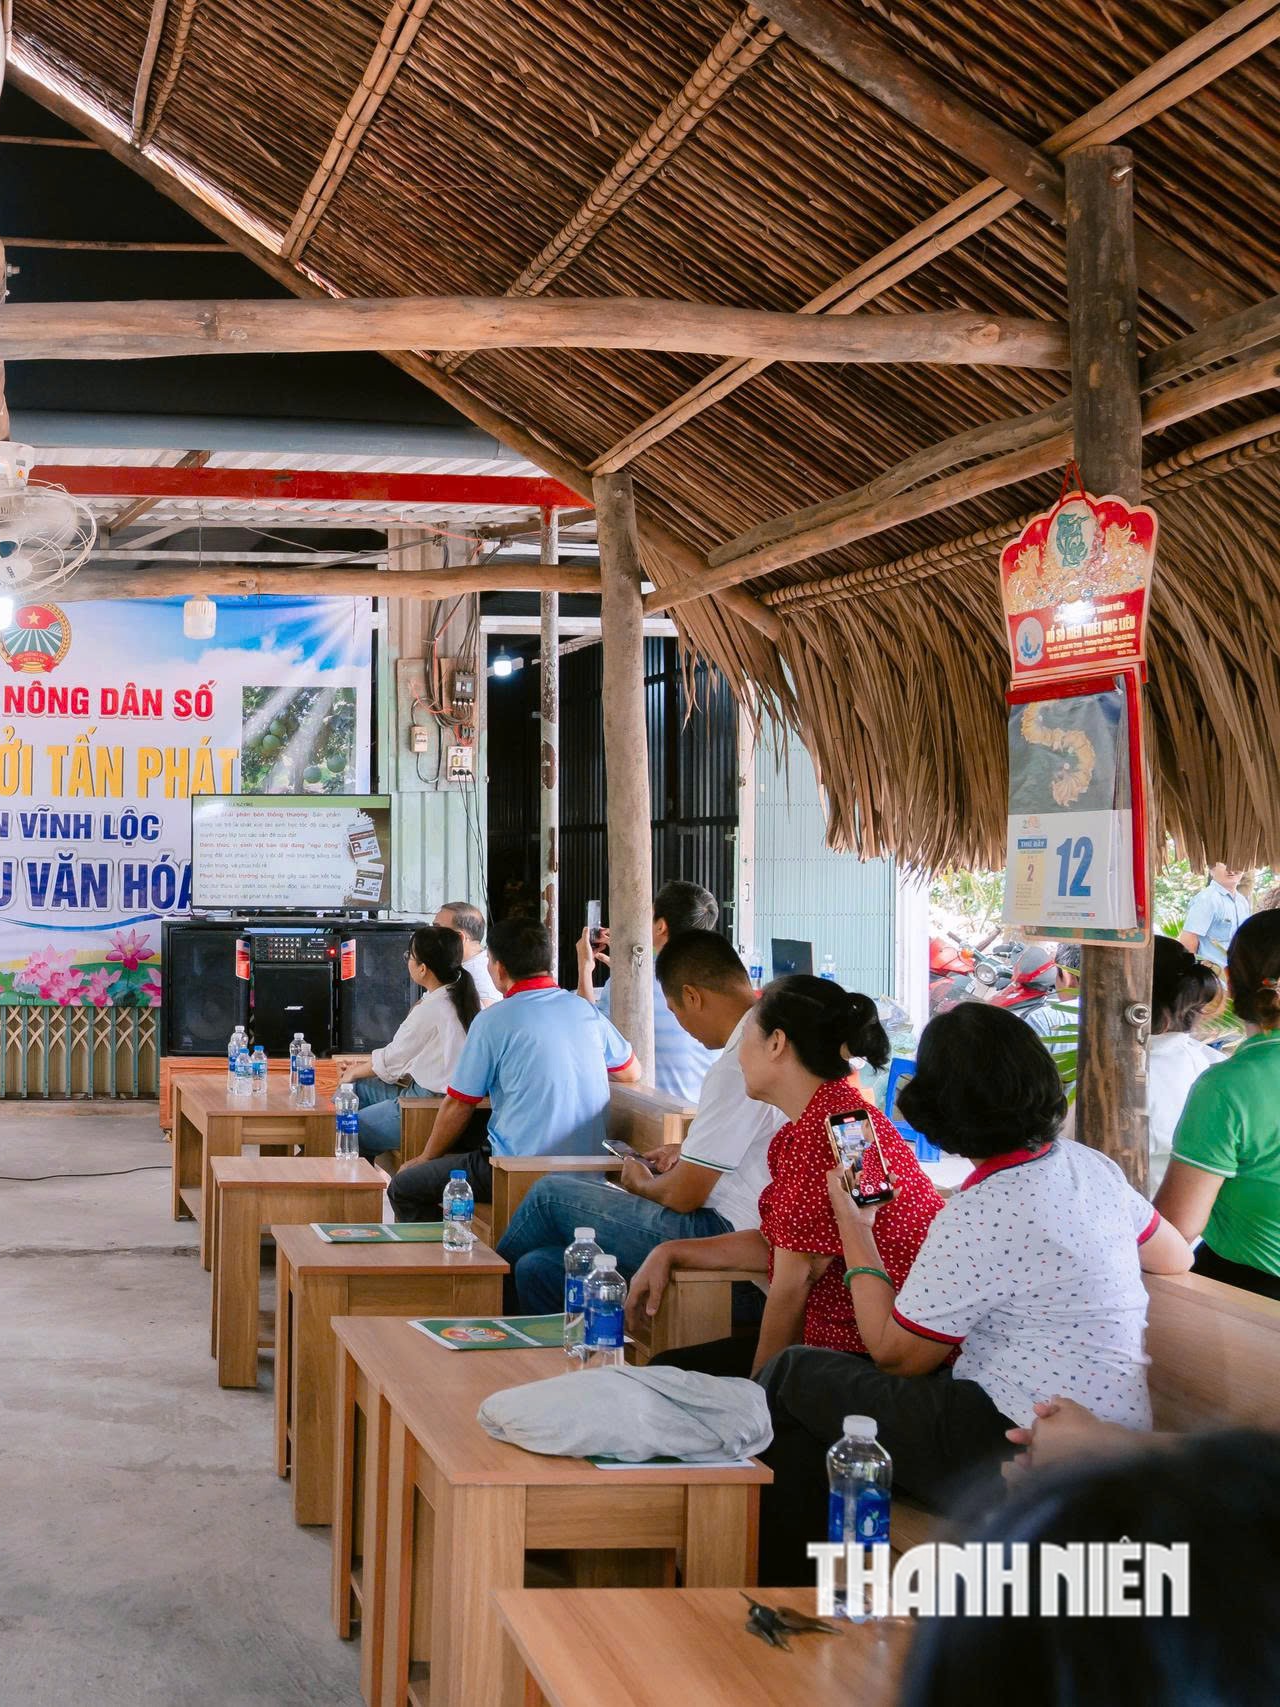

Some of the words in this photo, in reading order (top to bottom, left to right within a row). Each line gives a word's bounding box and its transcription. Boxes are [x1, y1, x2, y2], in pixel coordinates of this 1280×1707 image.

[4, 680, 90, 715] NÔNG
[100, 682, 163, 717] DÂN
[174, 680, 215, 718] SỐ
[46, 726, 124, 798] TẤN
[136, 736, 239, 799] PHÁT
[20, 808, 92, 840] VĨNH
[103, 809, 160, 846] LỘC
[26, 852, 108, 908] VĂN
[1027, 863, 1035, 882] 2
[1056, 836, 1094, 896] 12
